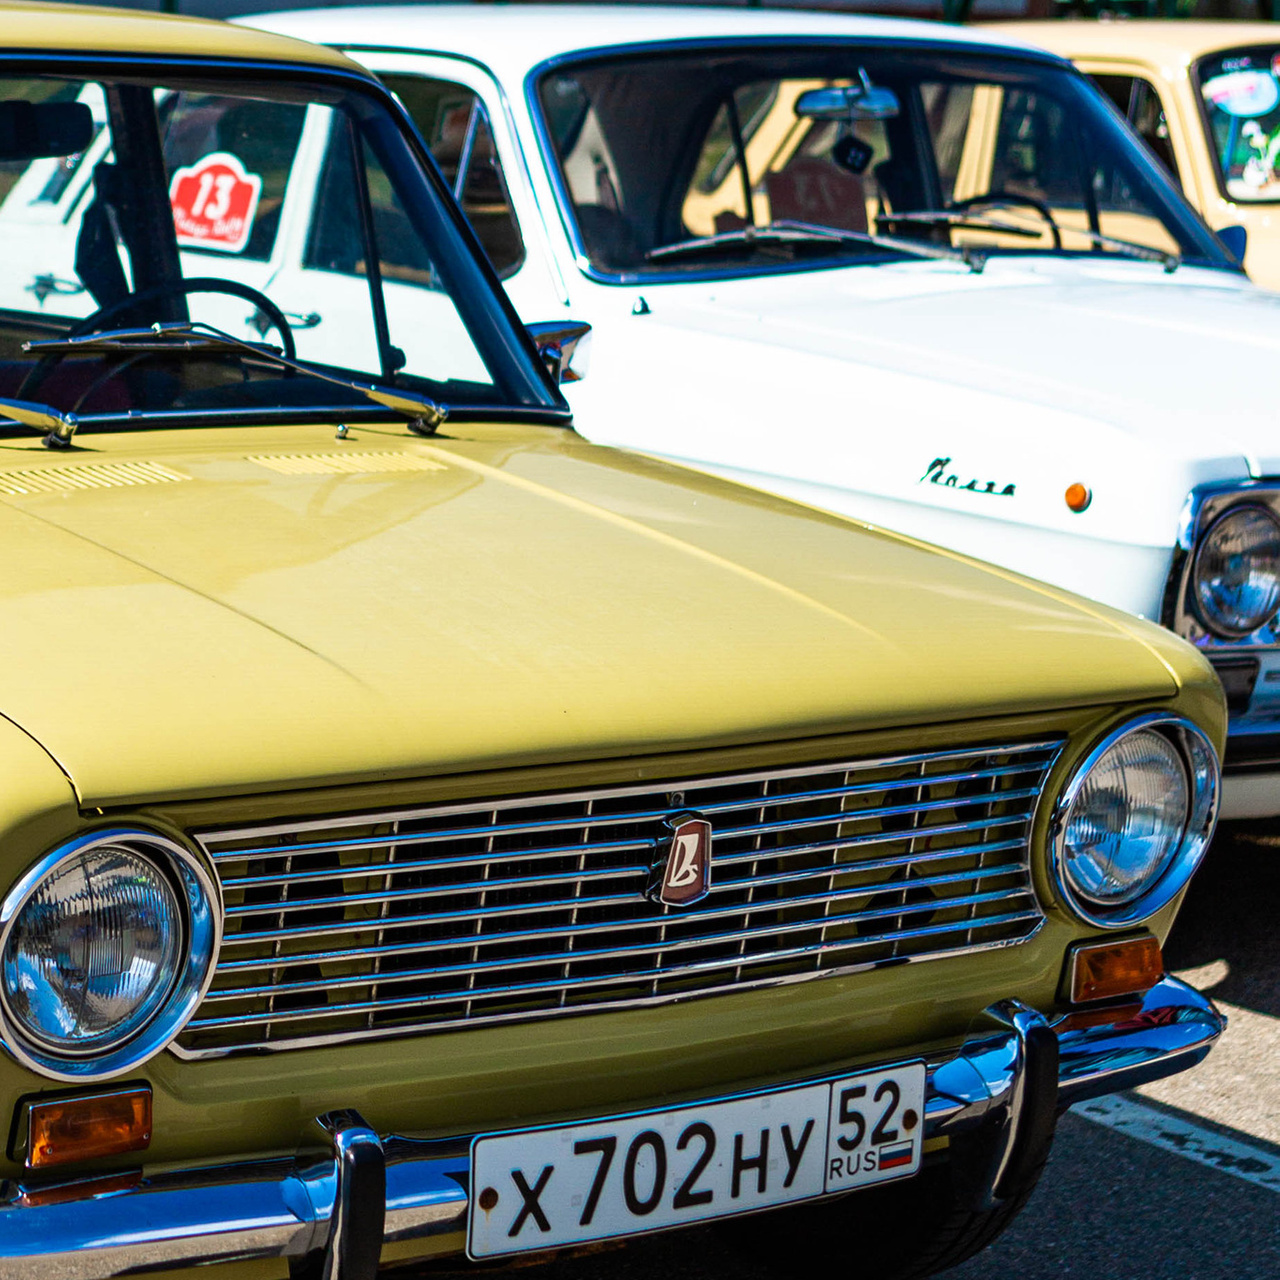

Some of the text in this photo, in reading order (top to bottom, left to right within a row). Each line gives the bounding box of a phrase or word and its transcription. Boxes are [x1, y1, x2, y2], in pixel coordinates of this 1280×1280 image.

[190, 172, 237, 220] 13
[836, 1079, 902, 1152] 52
[829, 1151, 878, 1181] RUS
